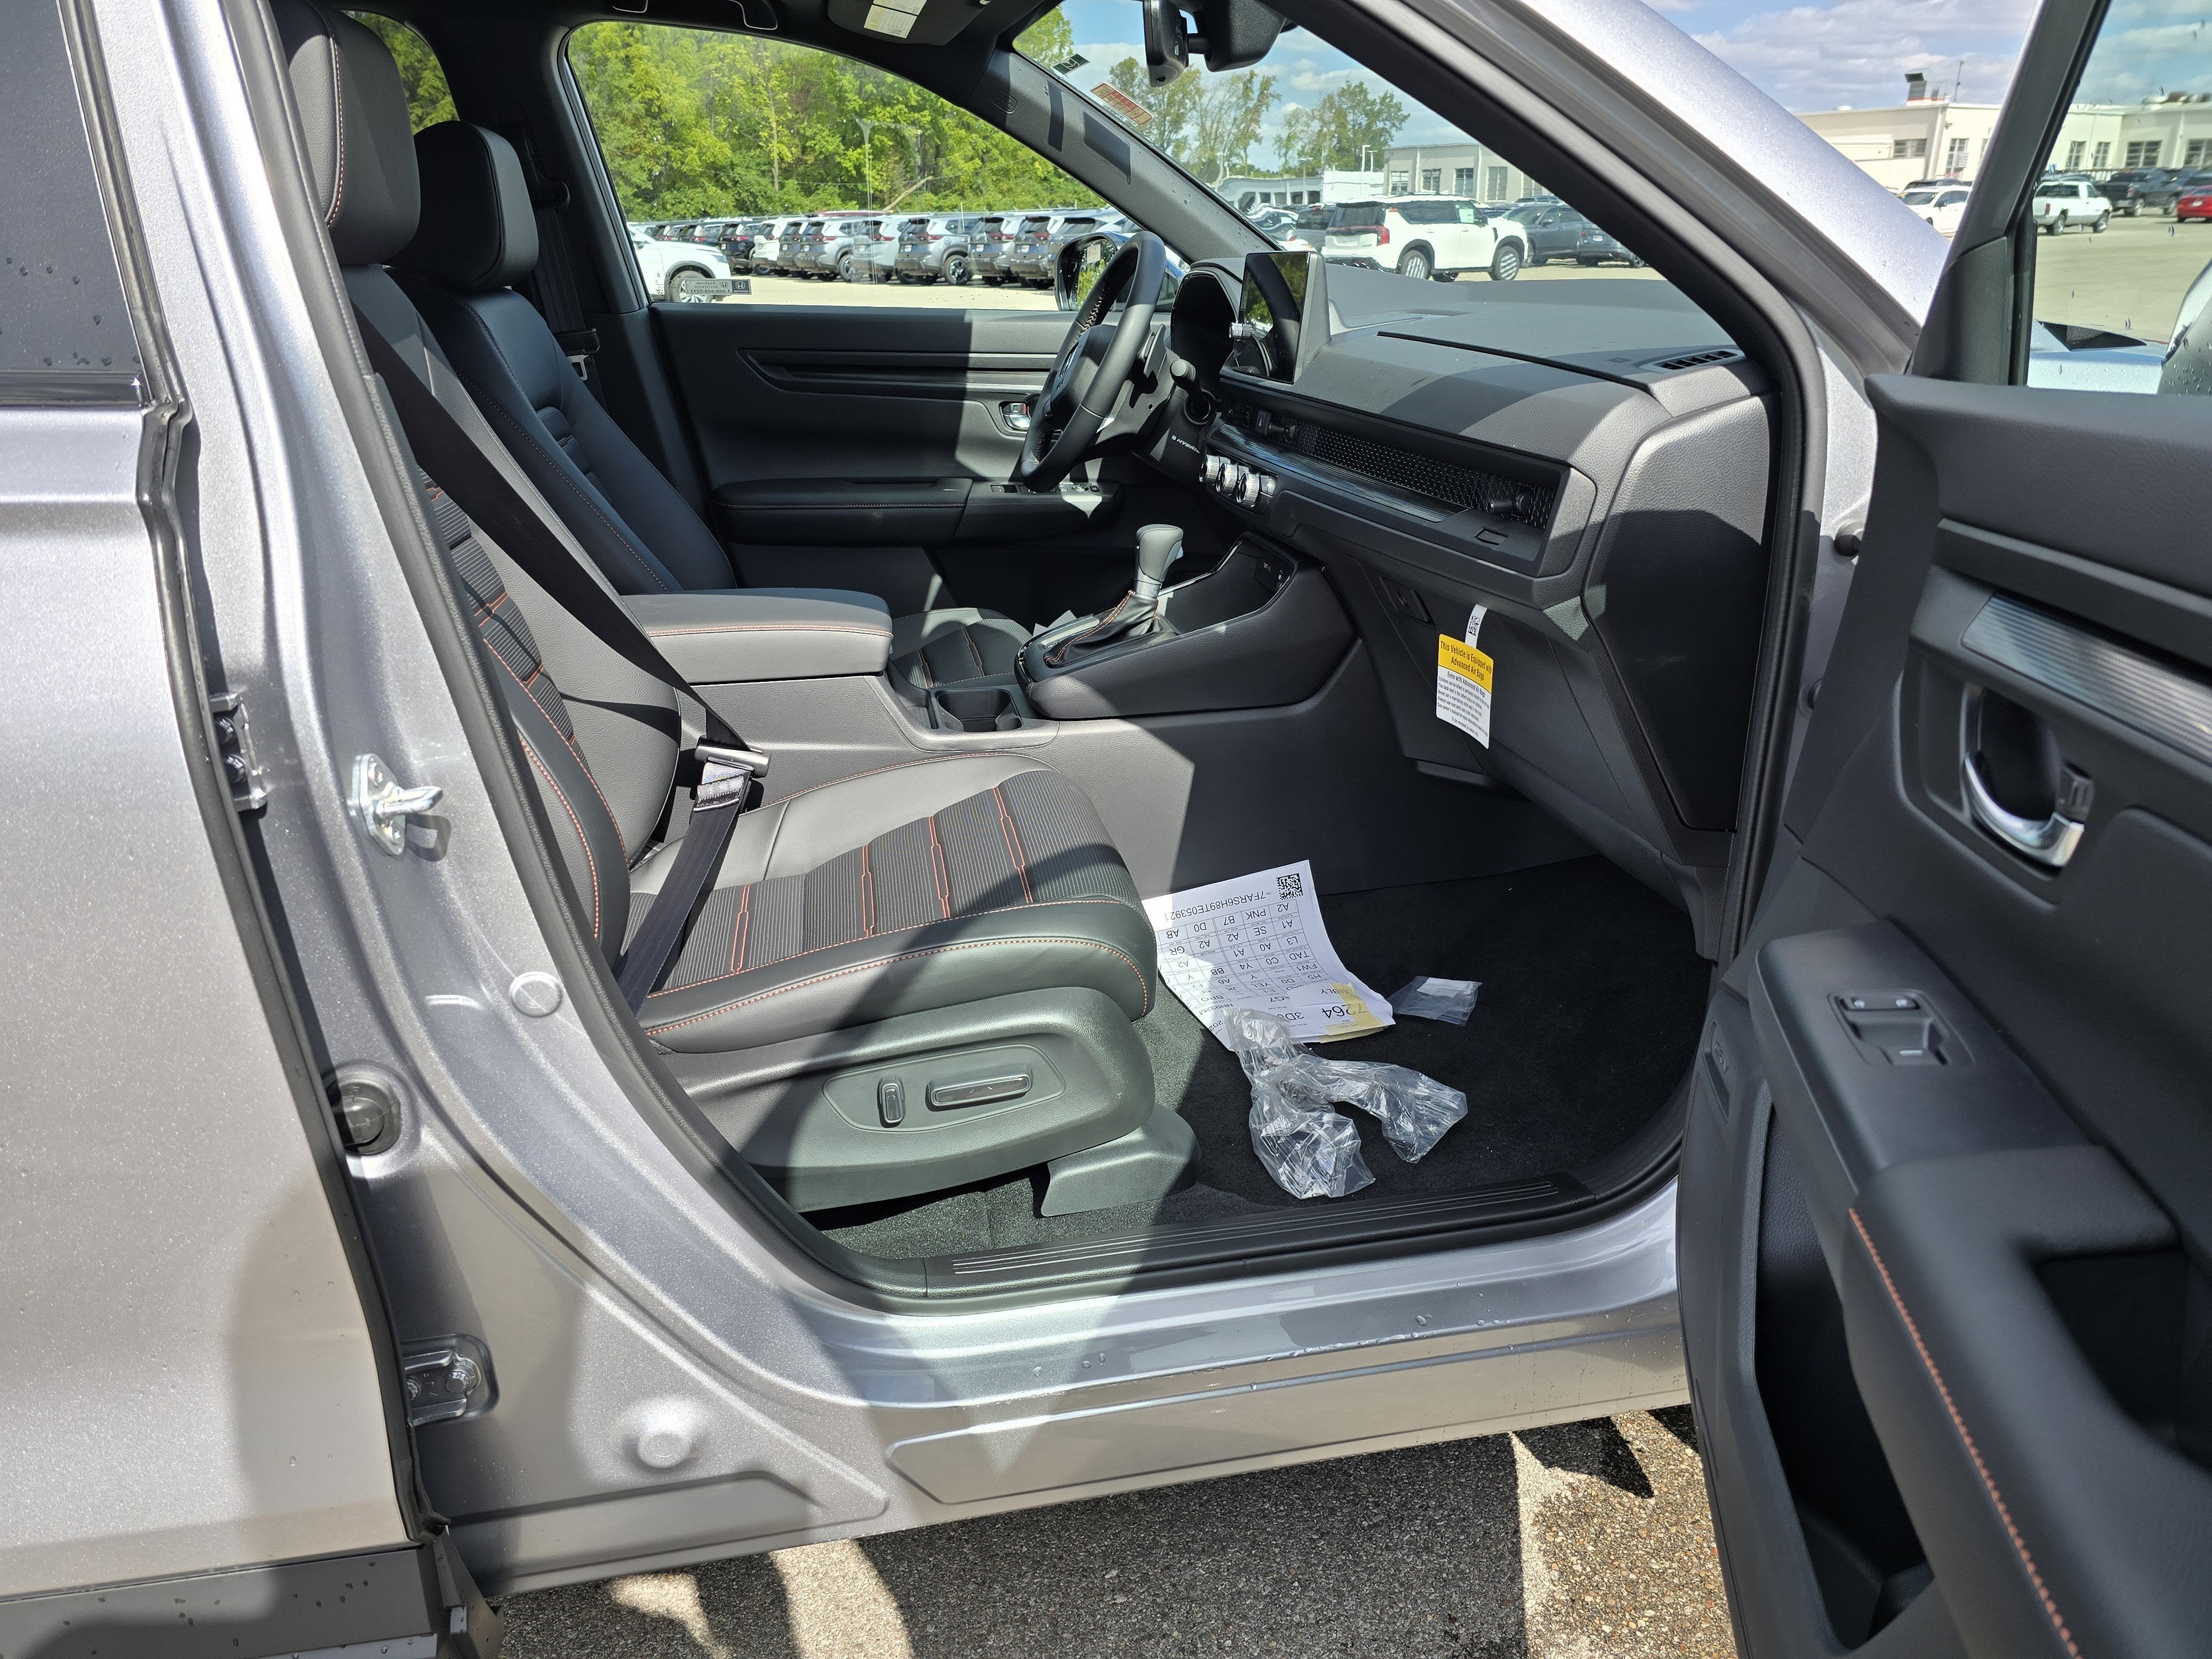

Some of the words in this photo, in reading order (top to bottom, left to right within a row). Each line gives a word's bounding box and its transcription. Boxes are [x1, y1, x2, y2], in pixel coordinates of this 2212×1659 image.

[1441, 641, 1449, 651] This
[1451, 644, 1465, 658] Vehicle
[1467, 651, 1470, 660] is
[1471, 654, 1486, 670] Equipped
[1451, 656, 1470, 672] Advanced
[1463, 679, 1476, 691] Advanced
[1165, 891, 1265, 921] 7FARS6H89TE053921
[1277, 902, 1288, 912] A2
[1245, 909, 1266, 920] PNK
[1223, 916, 1235, 925] B7
[1282, 919, 1292, 928] A1
[1166, 928, 1179, 938] AB
[1253, 926, 1266, 936] SE
[1226, 932, 1239, 942] A2
[1286, 936, 1298, 945] L3
[1198, 939, 1211, 948] A2
[1169, 946, 1185, 956] GR
[1233, 948, 1244, 957] A1
[1289, 951, 1310, 960] TAD
[1321, 1003, 1368, 1019] 7264
